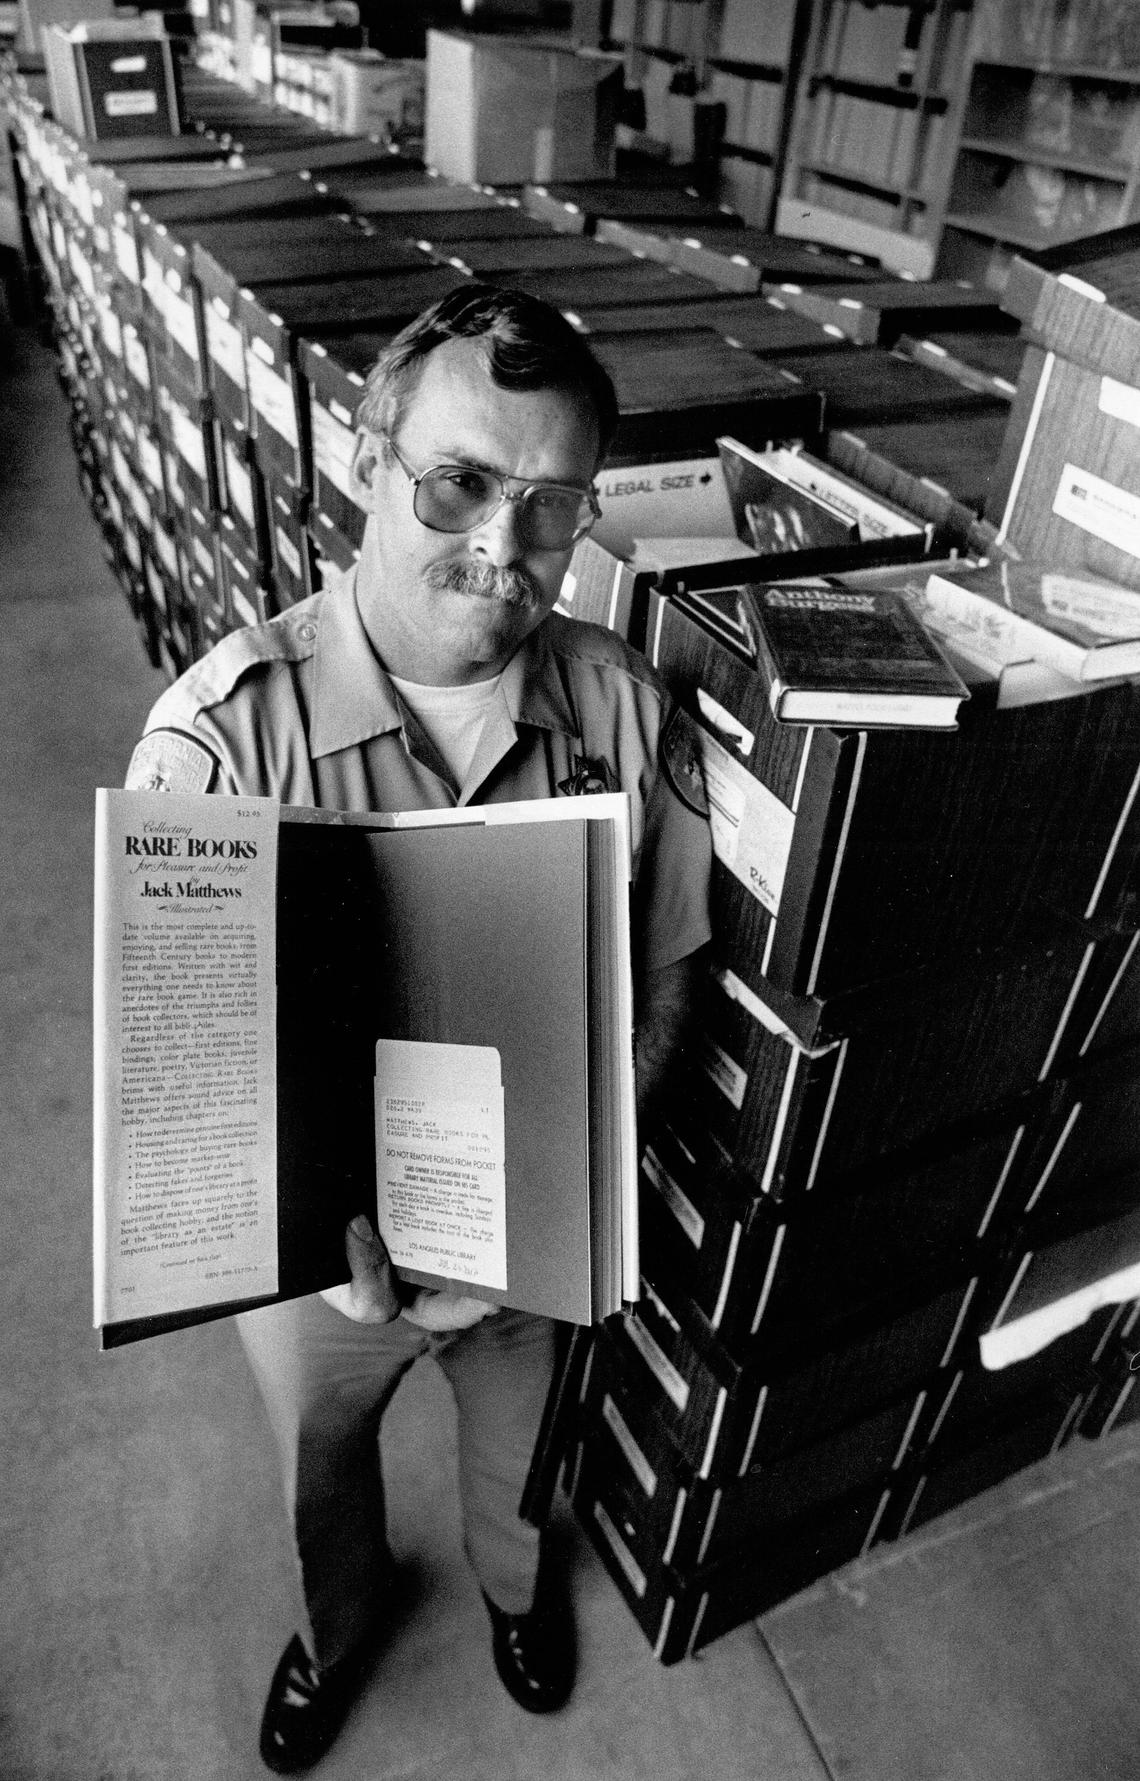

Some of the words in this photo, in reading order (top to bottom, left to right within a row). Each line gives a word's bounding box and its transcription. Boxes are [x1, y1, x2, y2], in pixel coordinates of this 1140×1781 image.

[605, 480, 654, 497] LEGAL
[660, 474, 694, 491] SIZE
[144, 821, 192, 838] Collecting
[126, 836, 181, 857] RARE
[188, 838, 258, 859] BOOKS
[130, 859, 152, 874] for
[153, 859, 195, 872] Pleasure
[198, 862, 218, 872] and
[218, 862, 248, 876] Profit
[140, 881, 172, 898] Jack
[176, 882, 242, 898] Matthews
[168, 903, 213, 914] Illustrated
[122, 922, 138, 930] This
[166, 922, 184, 930] most
[186, 922, 218, 931] complete
[122, 932, 138, 940] date
[143, 932, 170, 940] volume
[174, 932, 204, 940] available
[160, 952, 191, 961] Century
[230, 951, 257, 959] modern
[208, 961, 226, 969] with
[244, 960, 257, 968] and
[170, 972, 188, 980] book
[193, 971, 224, 981] presents
[228, 970, 257, 979] virtually
[122, 983, 162, 992] everything
[156, 992, 174, 1000] book
[122, 1003, 160, 1012] anecdotes
[186, 1000, 220, 1010] triumphs
[132, 1014, 150, 1022] book
[192, 1010, 214, 1019] which
[215, 1009, 240, 1017] should
[122, 1023, 151, 1032] interest
[130, 1033, 174, 1043] Regardless
[207, 1030, 240, 1038] category
[160, 1053, 180, 1061] color
[409, 1152, 432, 1162] REMOVE
[433, 1155, 454, 1165] FORMS
[473, 1160, 496, 1170] POCKET
